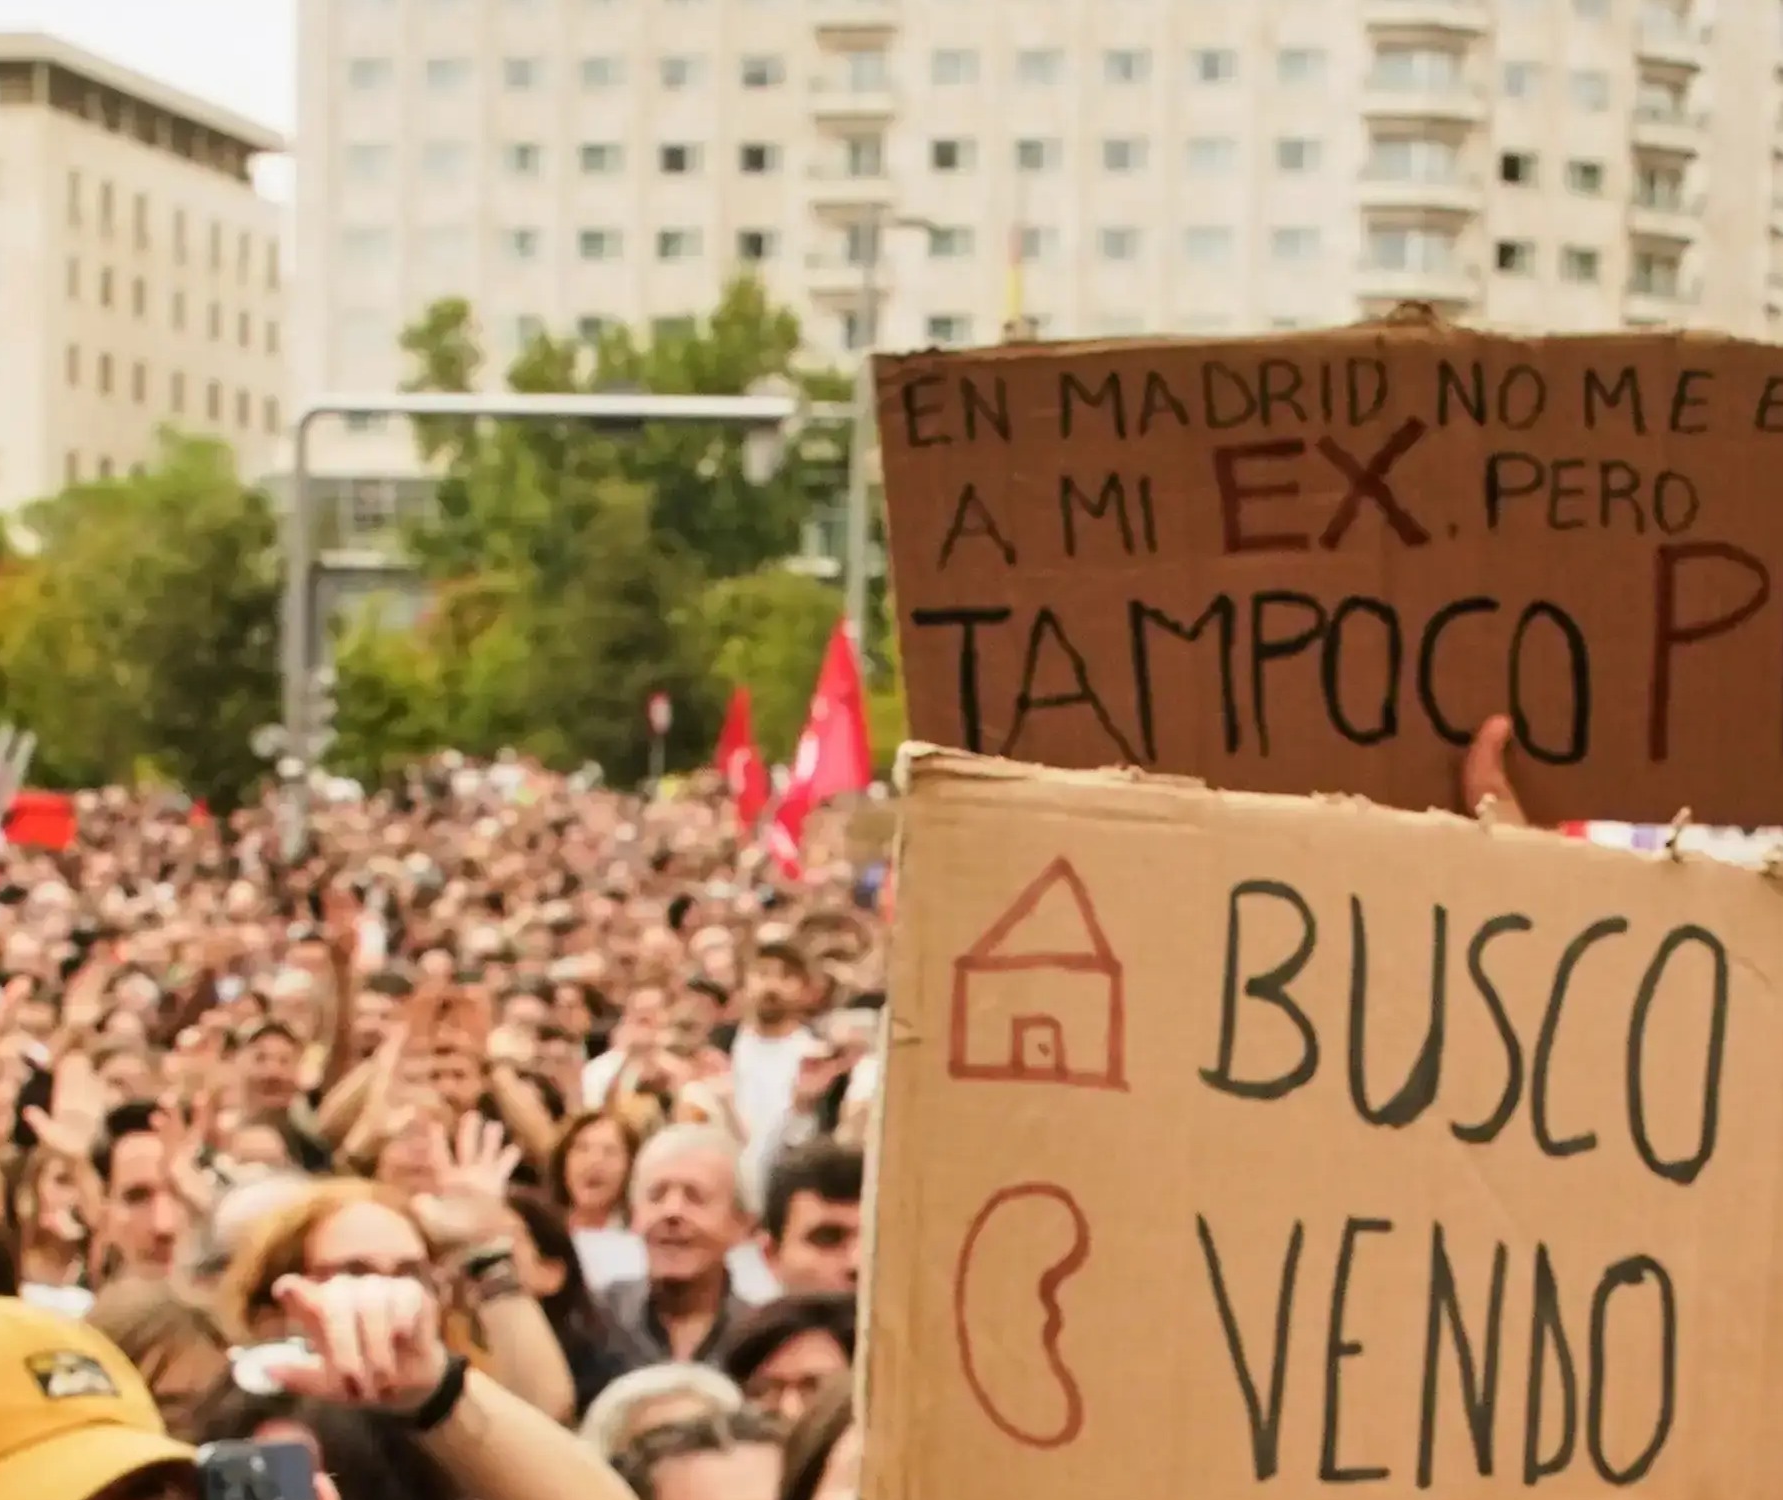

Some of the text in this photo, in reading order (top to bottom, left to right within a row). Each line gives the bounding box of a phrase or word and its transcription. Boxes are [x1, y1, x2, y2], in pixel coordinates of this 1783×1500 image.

[902, 371, 1012, 448] EN
[1059, 358, 1389, 441] MADRID
[1437, 358, 1547, 432] NO
[1583, 365, 1715, 436] ME
[937, 482, 1017, 571] A
[1059, 471, 1158, 557] MI
[1483, 450, 1700, 536] PERO
[910, 589, 1592, 766] TAMPOCO
[1197, 878, 1729, 1186] BUSCO
[1195, 1212, 1678, 1491] VENDO
